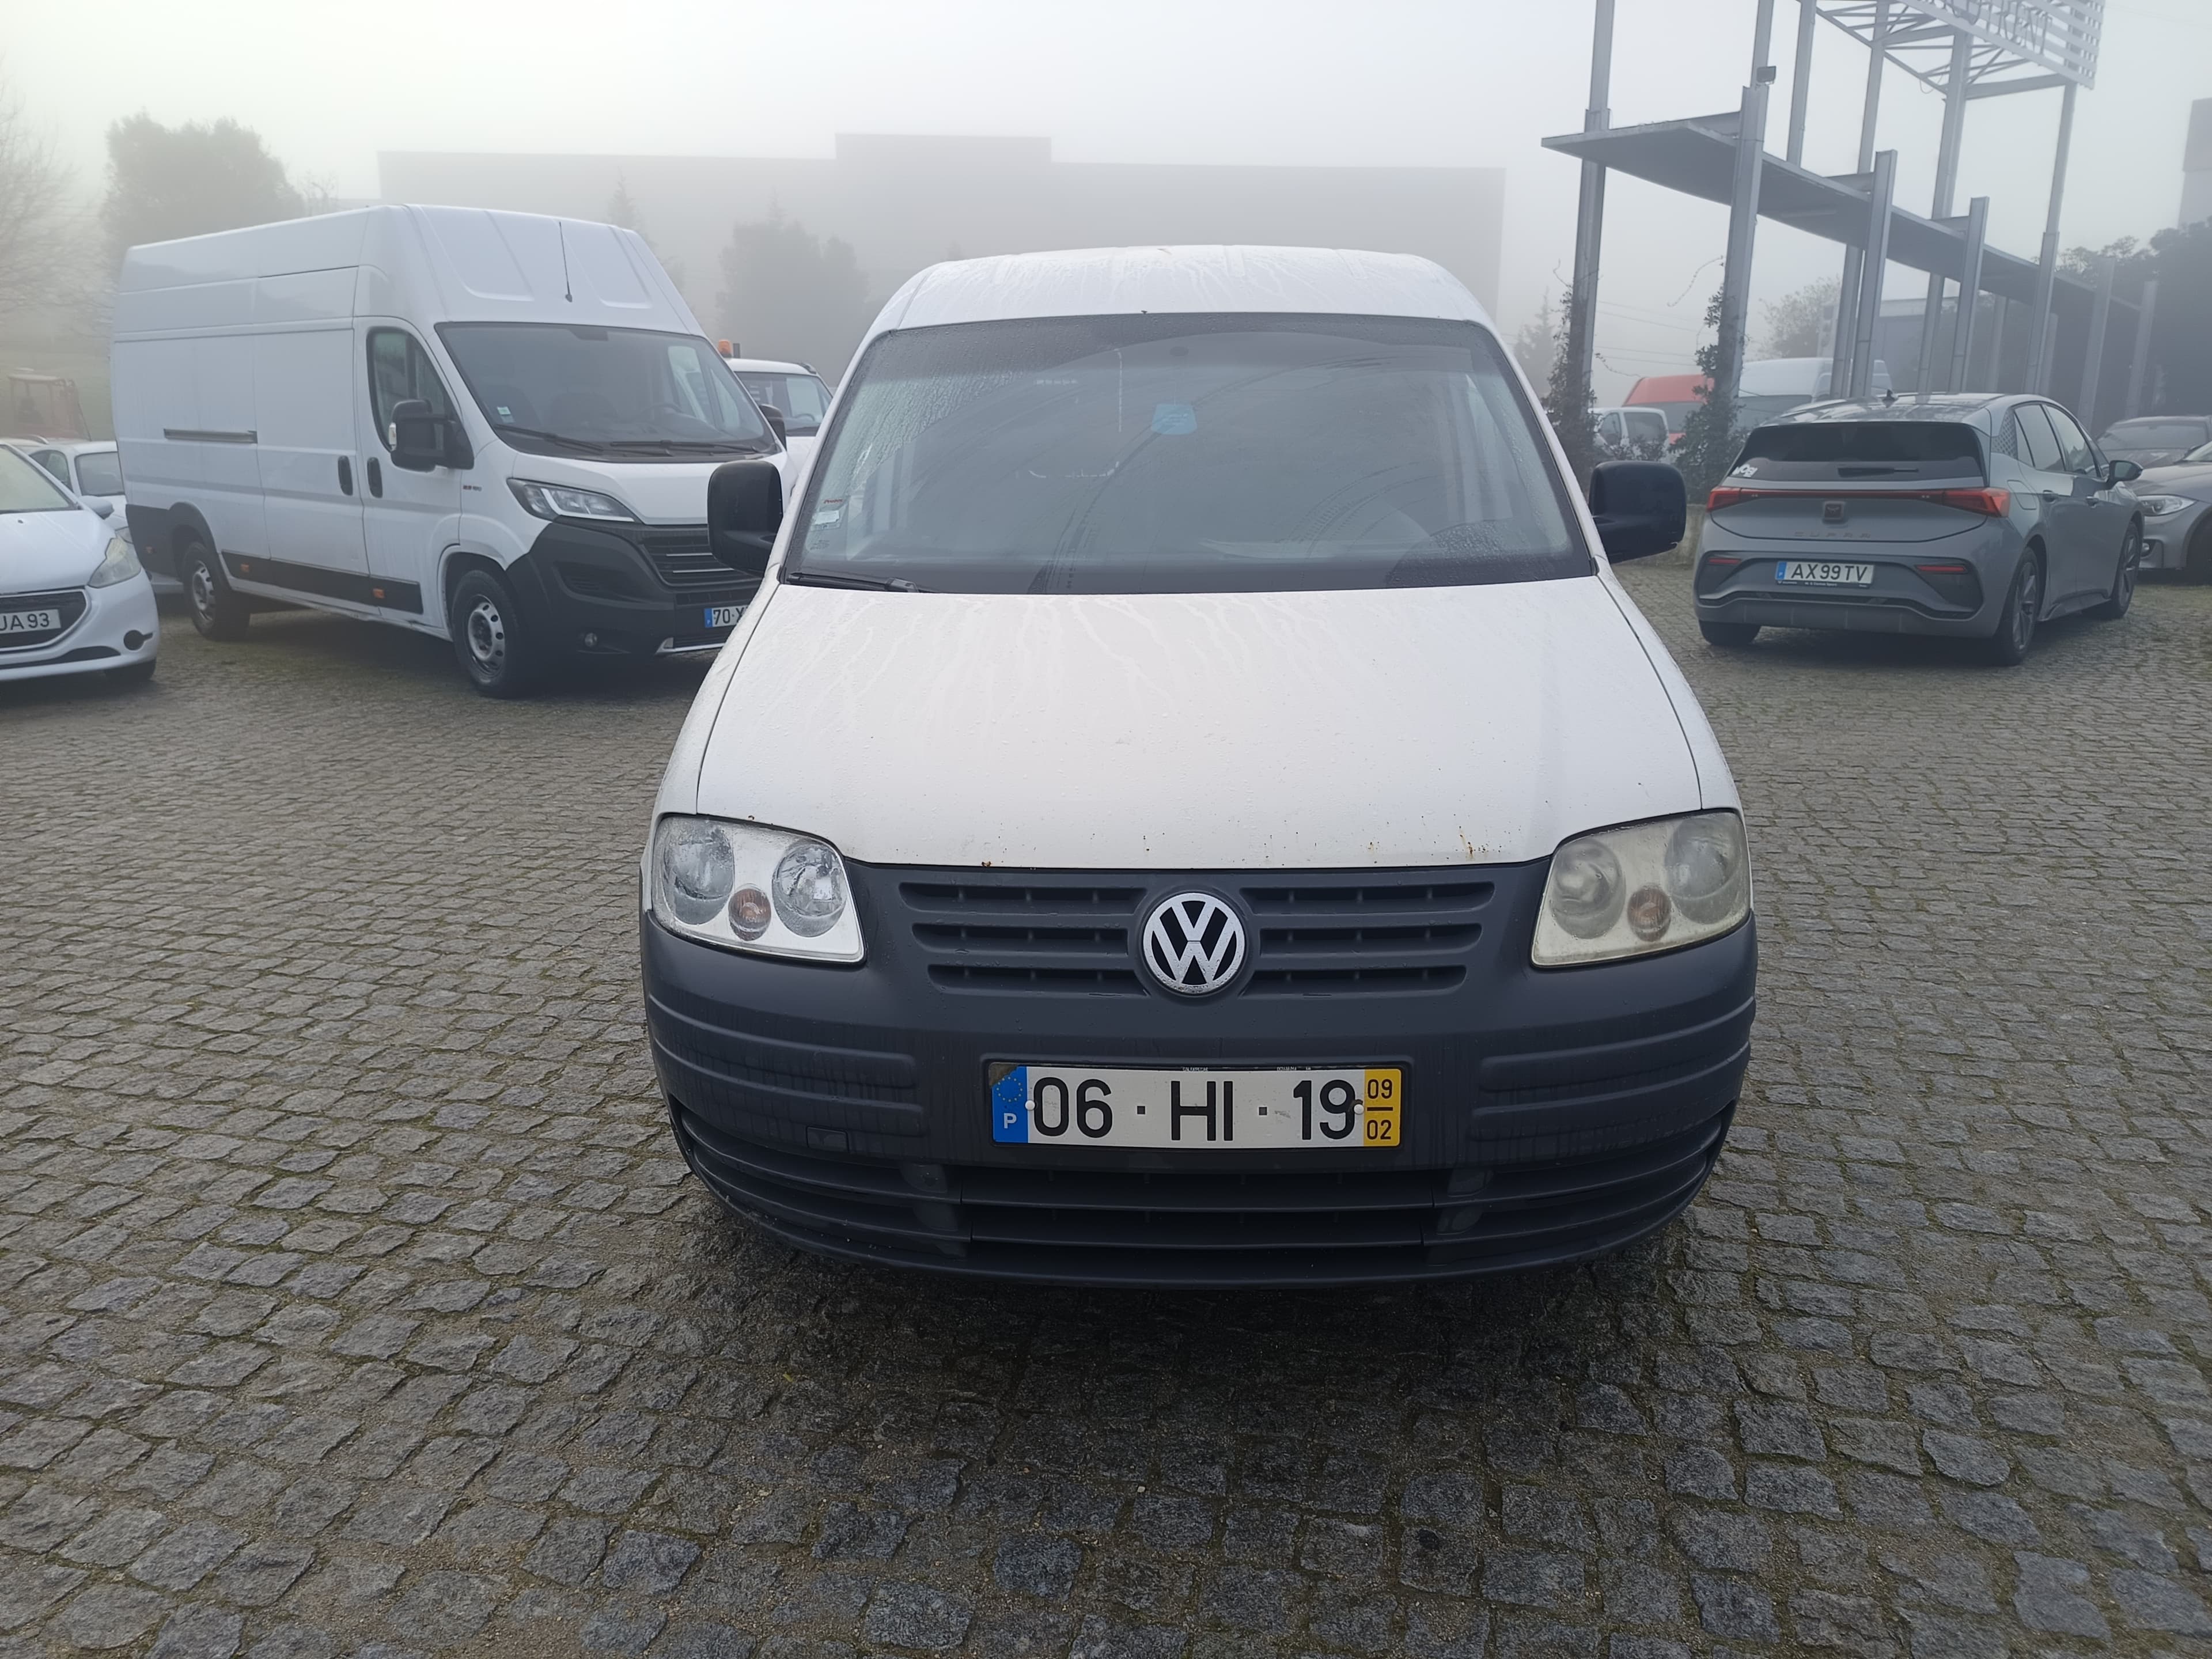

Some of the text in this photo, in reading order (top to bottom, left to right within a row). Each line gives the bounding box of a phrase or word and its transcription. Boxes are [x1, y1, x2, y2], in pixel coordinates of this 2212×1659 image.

[1791, 563, 1868, 581] AX 99 TV
[28, 612, 50, 628] 93
[713, 608, 730, 625] 70
[1368, 1079, 1393, 1100] 09
[1033, 1077, 1356, 1141] 06 HI 19
[1003, 1113, 1017, 1128] P
[1366, 1119, 1392, 1140] 02
